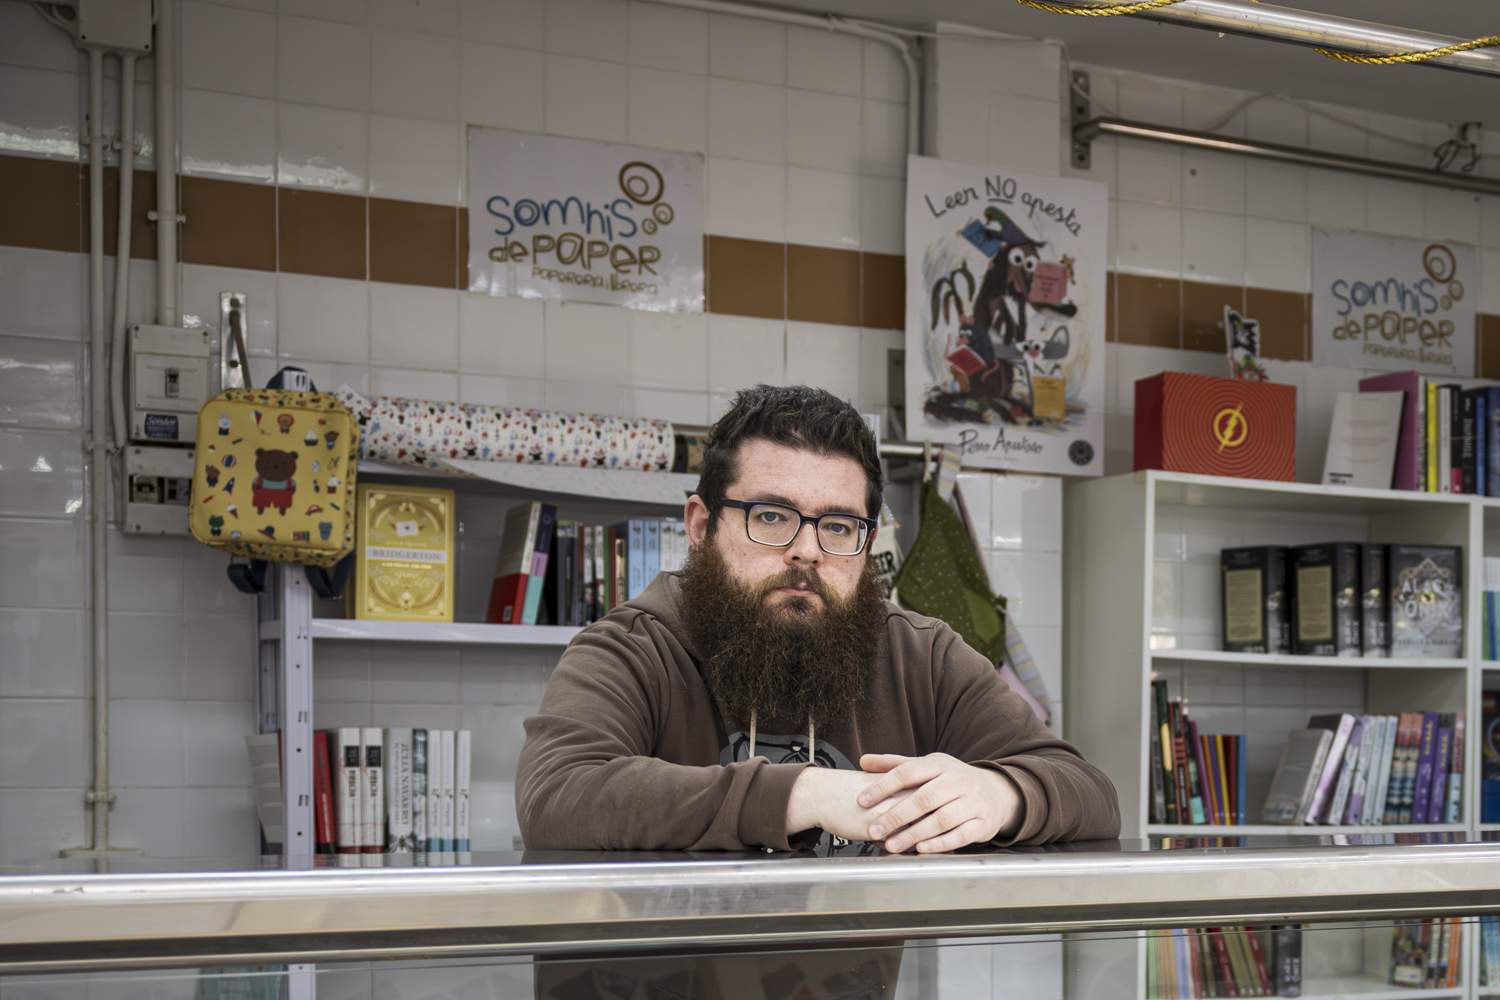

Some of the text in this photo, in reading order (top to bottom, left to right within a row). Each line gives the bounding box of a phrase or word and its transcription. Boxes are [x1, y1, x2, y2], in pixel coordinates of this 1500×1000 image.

[984, 175, 1082, 236] NO apesta
[489, 237, 529, 262] de
[1333, 316, 1361, 341] de
